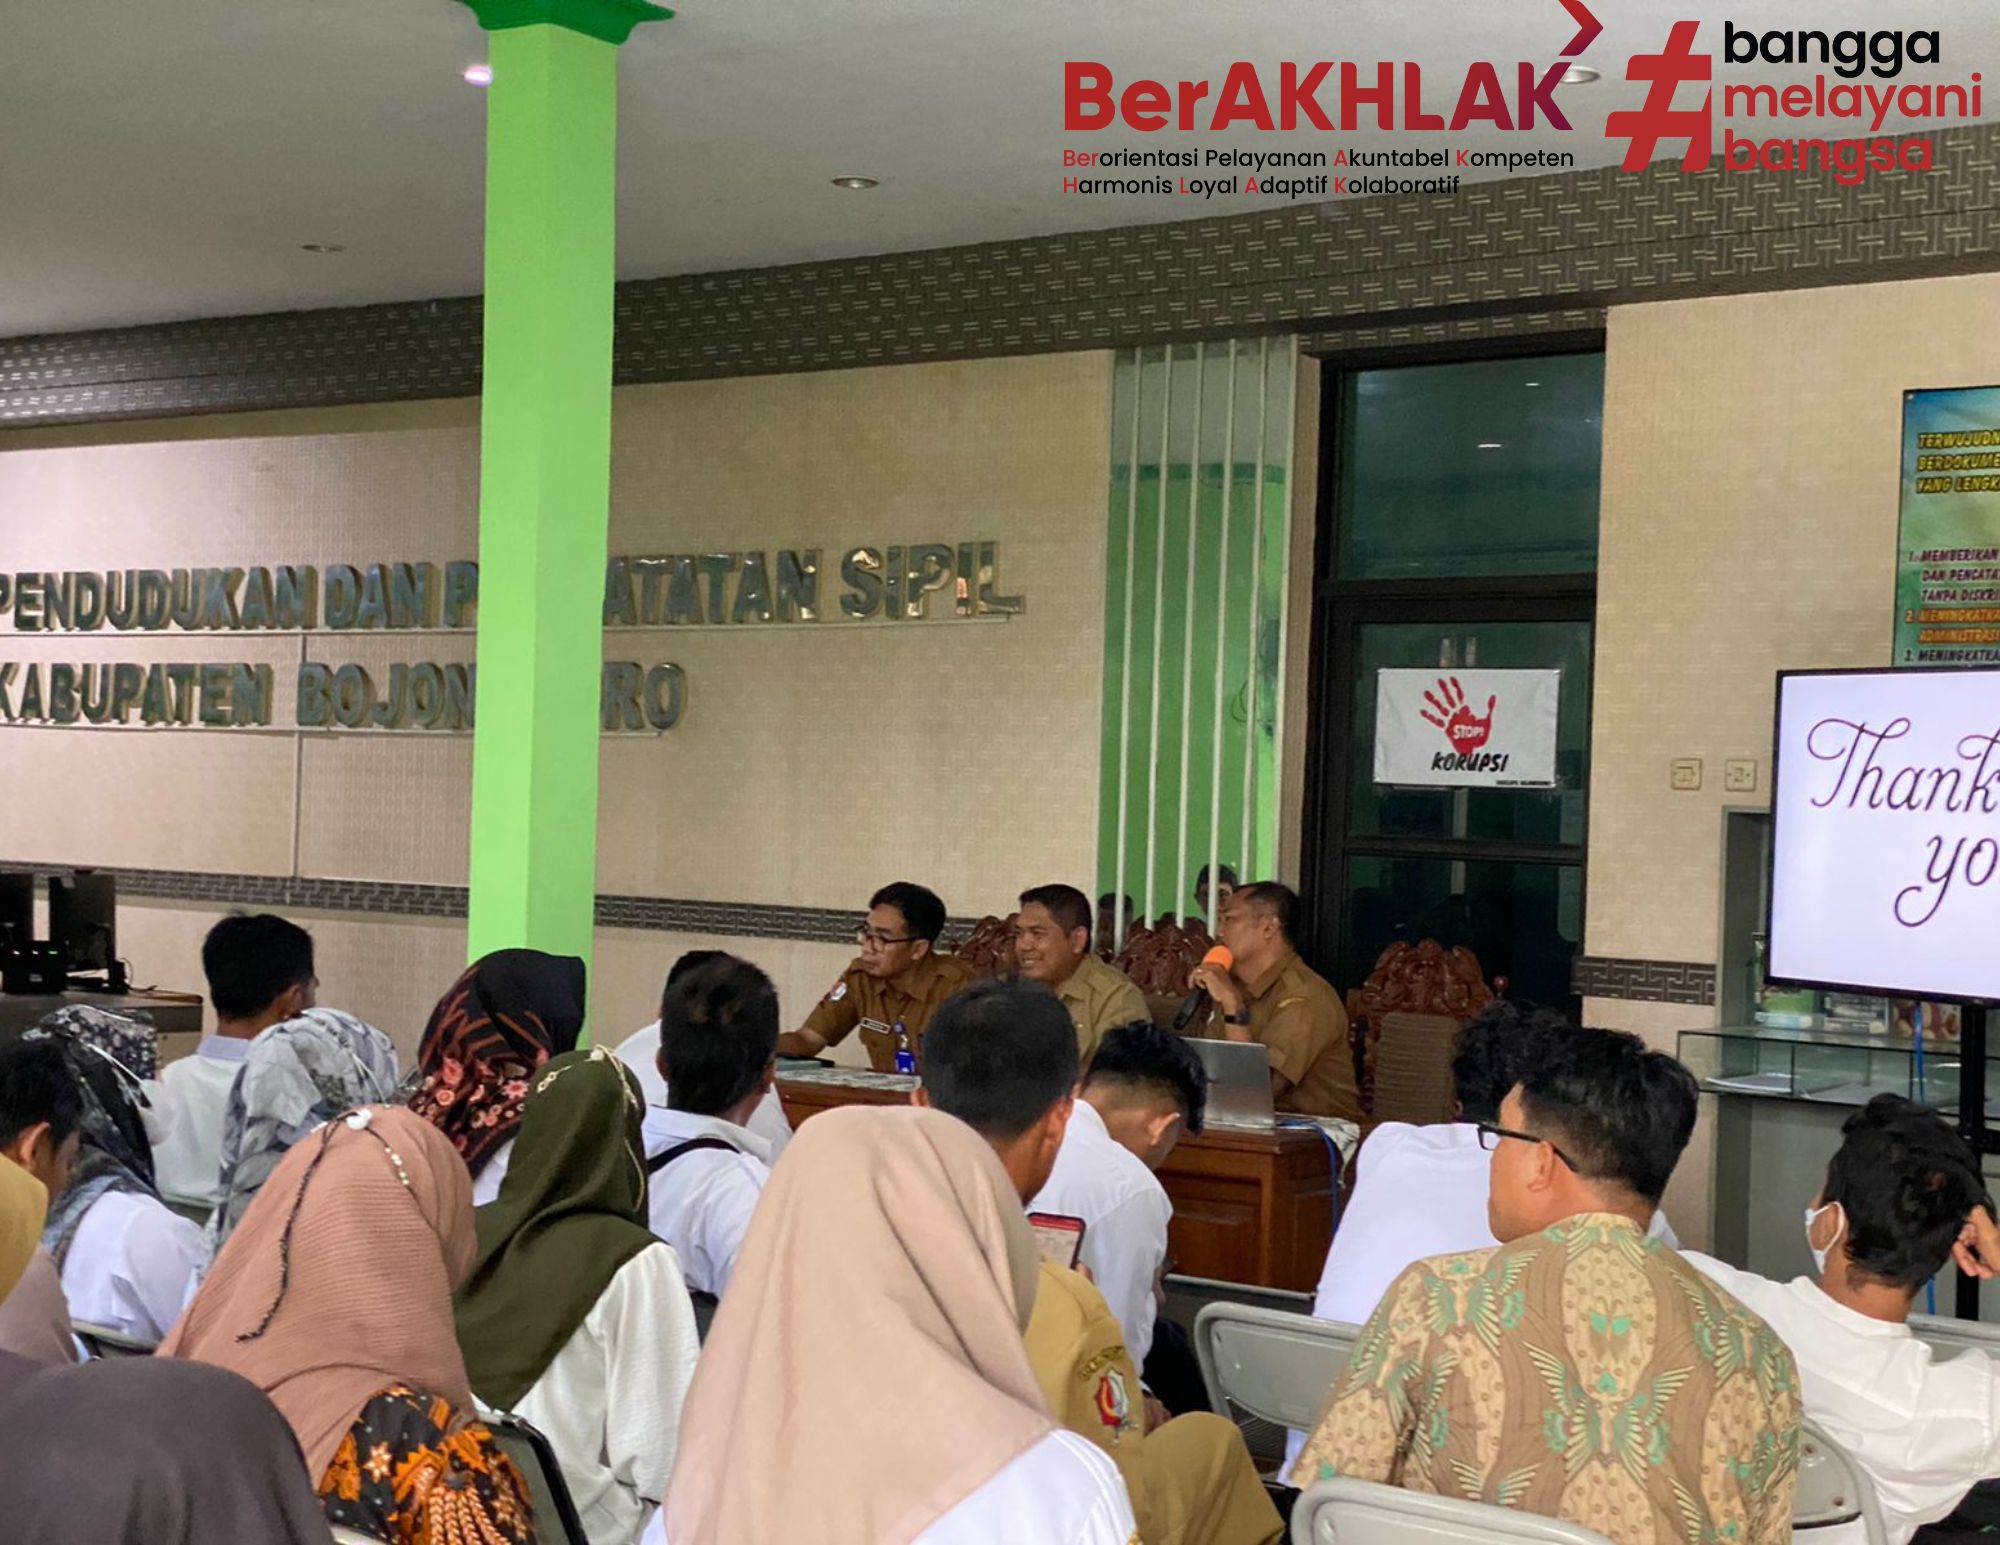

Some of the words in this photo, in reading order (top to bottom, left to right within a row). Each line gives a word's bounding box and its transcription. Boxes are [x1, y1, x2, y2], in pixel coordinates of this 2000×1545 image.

[1917, 477, 1952, 493] YANG
[1920, 549, 1998, 561] MEMBERIKAN
[1922, 570, 1945, 581] DAN
[325, 562, 439, 628] DAN
[444, 548, 822, 629] PATATAN
[840, 541, 1026, 619] SIPIL
[1922, 588, 1957, 601] TANPA
[0, 662, 274, 726] KABUPATEN
[298, 661, 687, 729] BOJONRO
[1431, 752, 1509, 772] KORUPSI
[1807, 717, 2000, 812] Thank
